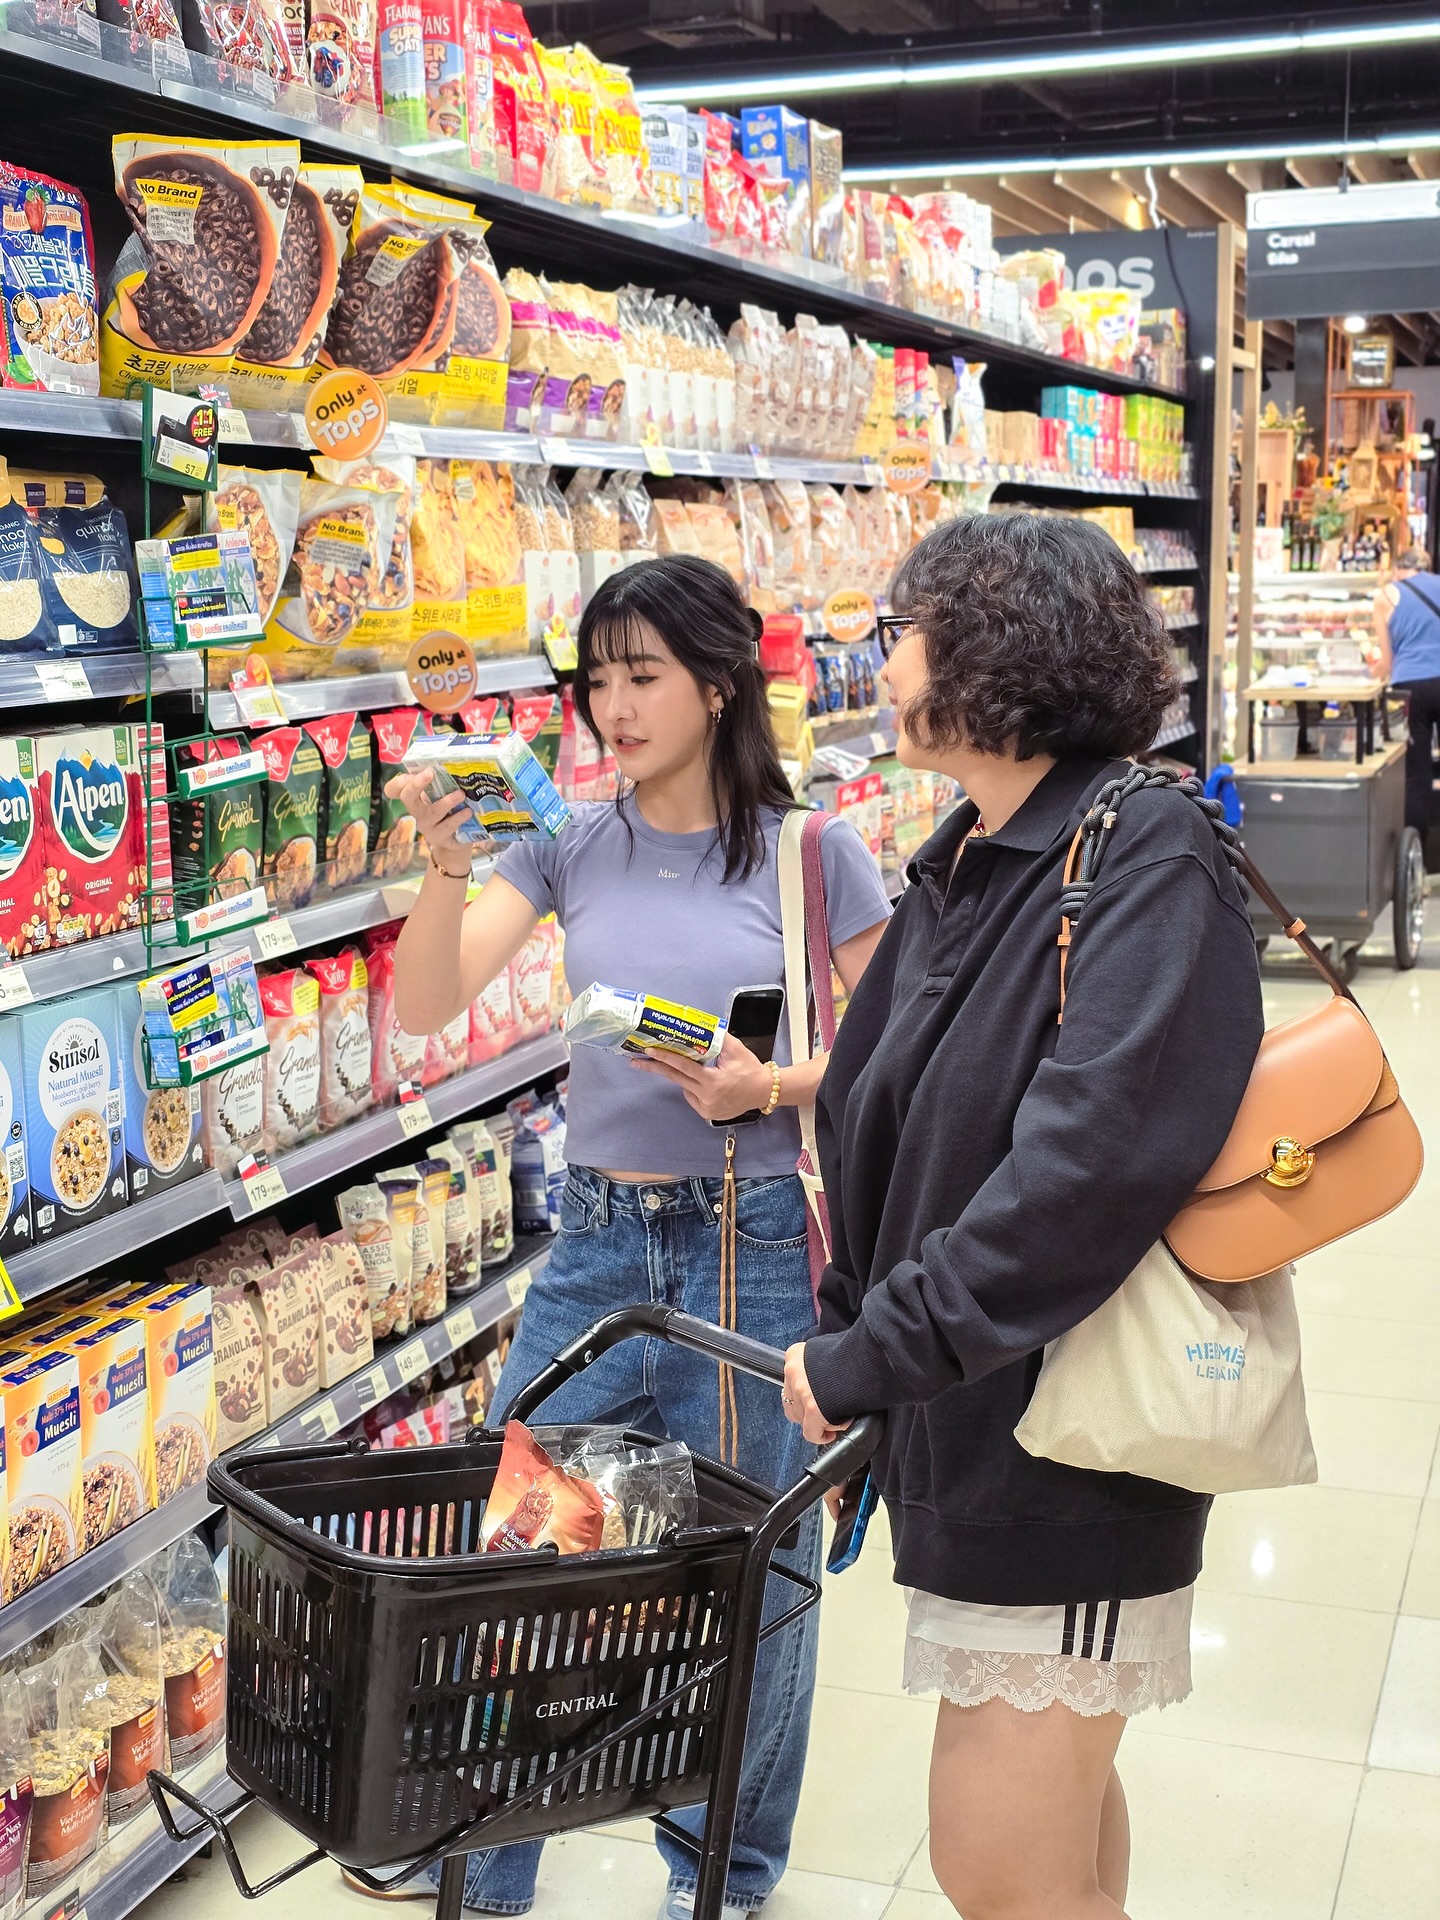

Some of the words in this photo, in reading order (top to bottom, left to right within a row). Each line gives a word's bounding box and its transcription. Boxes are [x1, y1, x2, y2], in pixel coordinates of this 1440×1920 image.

[140, 183, 155, 194] No
[158, 184, 198, 199] Brand
[124, 353, 171, 376] 초코링
[173, 362, 210, 377] 시리얼
[229, 366, 253, 382] 코링
[444, 364, 472, 382] 코링
[474, 367, 498, 385] 시리얼
[316, 390, 355, 420] Only
[356, 384, 367, 395] at
[219, 419, 231, 432] 99
[316, 398, 380, 447] Tops
[193, 427, 213, 437] FREE
[892, 455, 917, 466] Only
[185, 463, 196, 475] 57
[887, 466, 927, 481] Tops
[322, 522, 336, 531] No
[0, 530, 26, 543] noa
[832, 600, 858, 613] Only
[829, 609, 871, 630] Tops
[418, 650, 454, 670] Only
[456, 649, 466, 658] at
[417, 664, 473, 695] Tops
[116, 739, 126, 749] 30%
[19, 751, 31, 762] 30%
[20, 766, 32, 774] FRUIT
[58, 769, 124, 828] Alpen
[85, 877, 113, 891] ORIGINAL
[261, 933, 278, 949] 179
[227, 954, 250, 969] Anlene
[49, 1037, 100, 1073] Sunsol
[48, 1073, 79, 1093] Natural
[80, 1064, 104, 1083] Muesli
[52, 1087, 78, 1101] blueberry,
[79, 1082, 89, 1094] goji
[89, 1080, 102, 1090] berry
[60, 1095, 80, 1107] coconut
[86, 1089, 96, 1098] chia
[403, 1115, 418, 1131] 179
[250, 1184, 268, 1202] 179
[363, 1242, 391, 1255] ASSIC
[363, 1257, 393, 1267] ANOLA
[278, 1304, 310, 1334] GRANOLA
[449, 1325, 462, 1338] 149
[118, 1348, 138, 1365] HAHNE
[182, 1336, 210, 1363] Muesli
[213, 1336, 251, 1366] GRANOLA
[125, 1366, 134, 1377] 37%
[399, 1357, 413, 1371] 149
[47, 1384, 70, 1403] HAHNE
[114, 1371, 144, 1400] Muesli
[54, 1406, 65, 1418] 37%
[65, 1399, 78, 1411] Fruit
[44, 1410, 77, 1441] Muesli
[535, 1692, 619, 1718] CENTRAL
